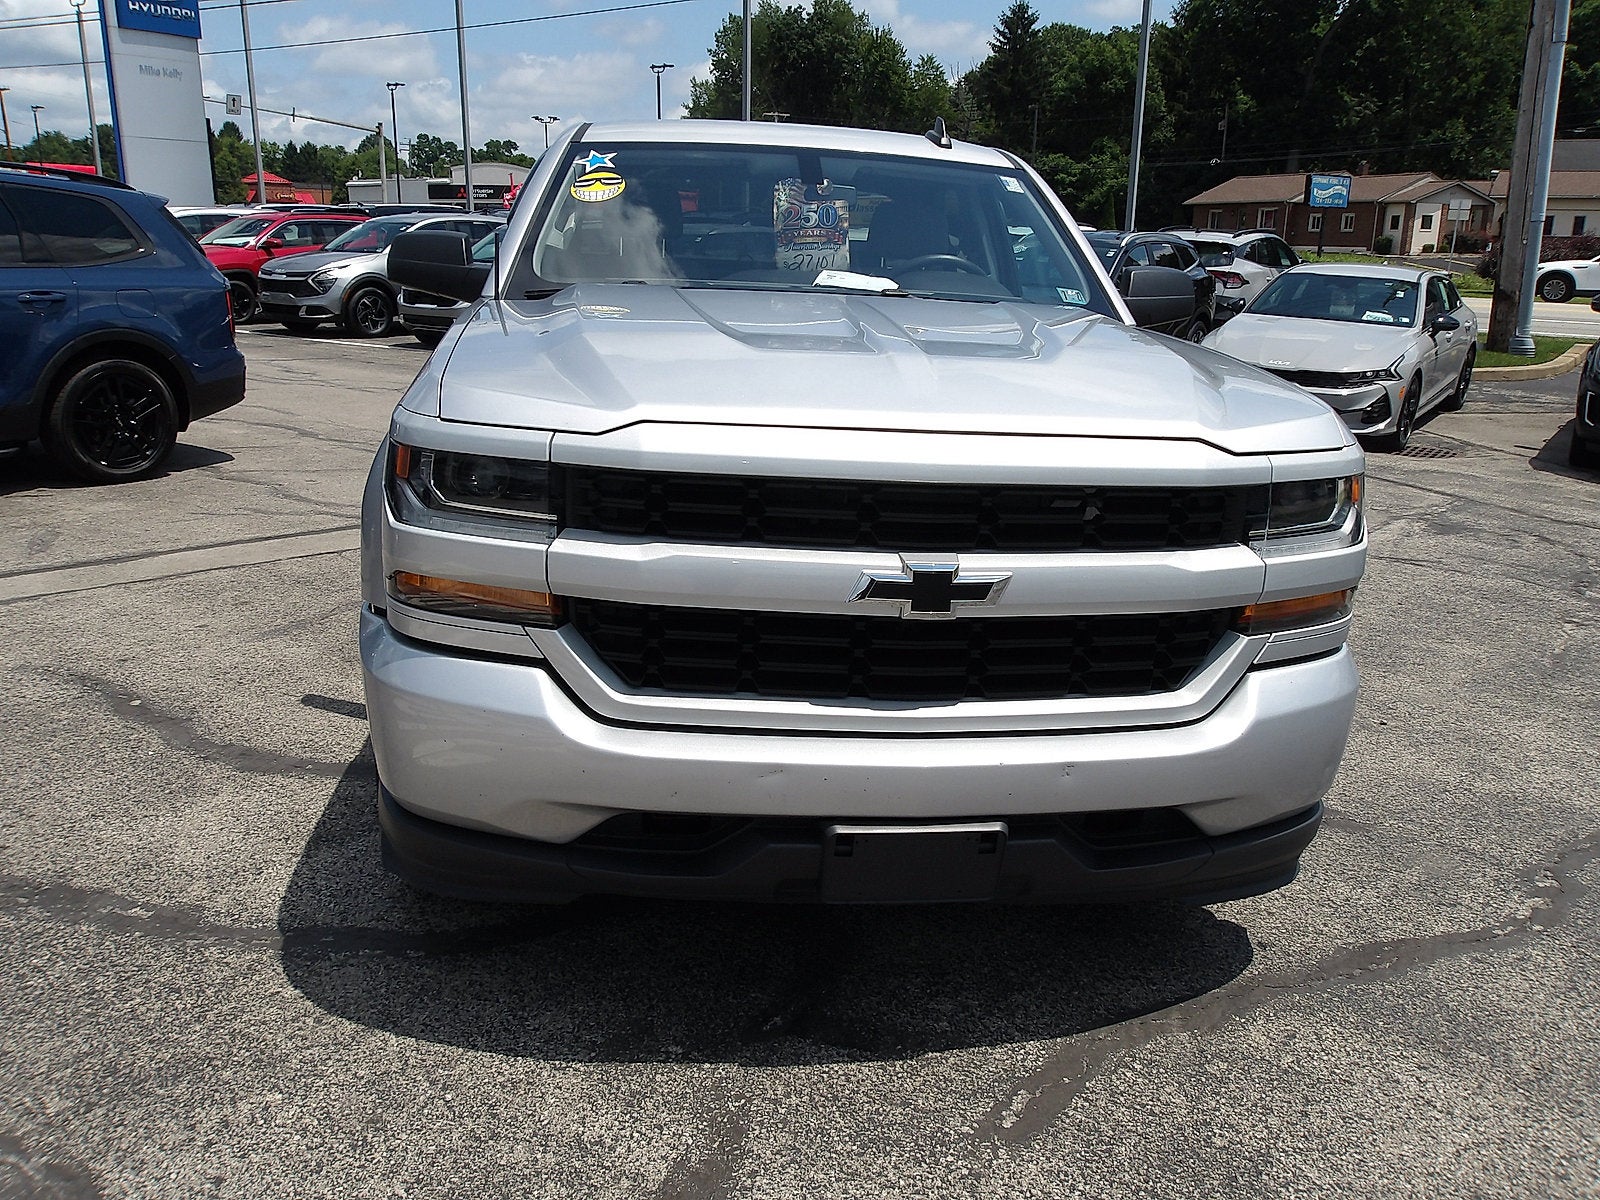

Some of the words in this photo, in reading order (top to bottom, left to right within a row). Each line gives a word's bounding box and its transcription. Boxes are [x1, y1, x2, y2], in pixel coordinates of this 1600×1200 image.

[128, 0, 196, 18] HYUNDAI
[139, 64, 161, 77] Mike
[162, 67, 183, 81] Kelly
[782, 203, 838, 228] 250
[784, 241, 817, 252] American
